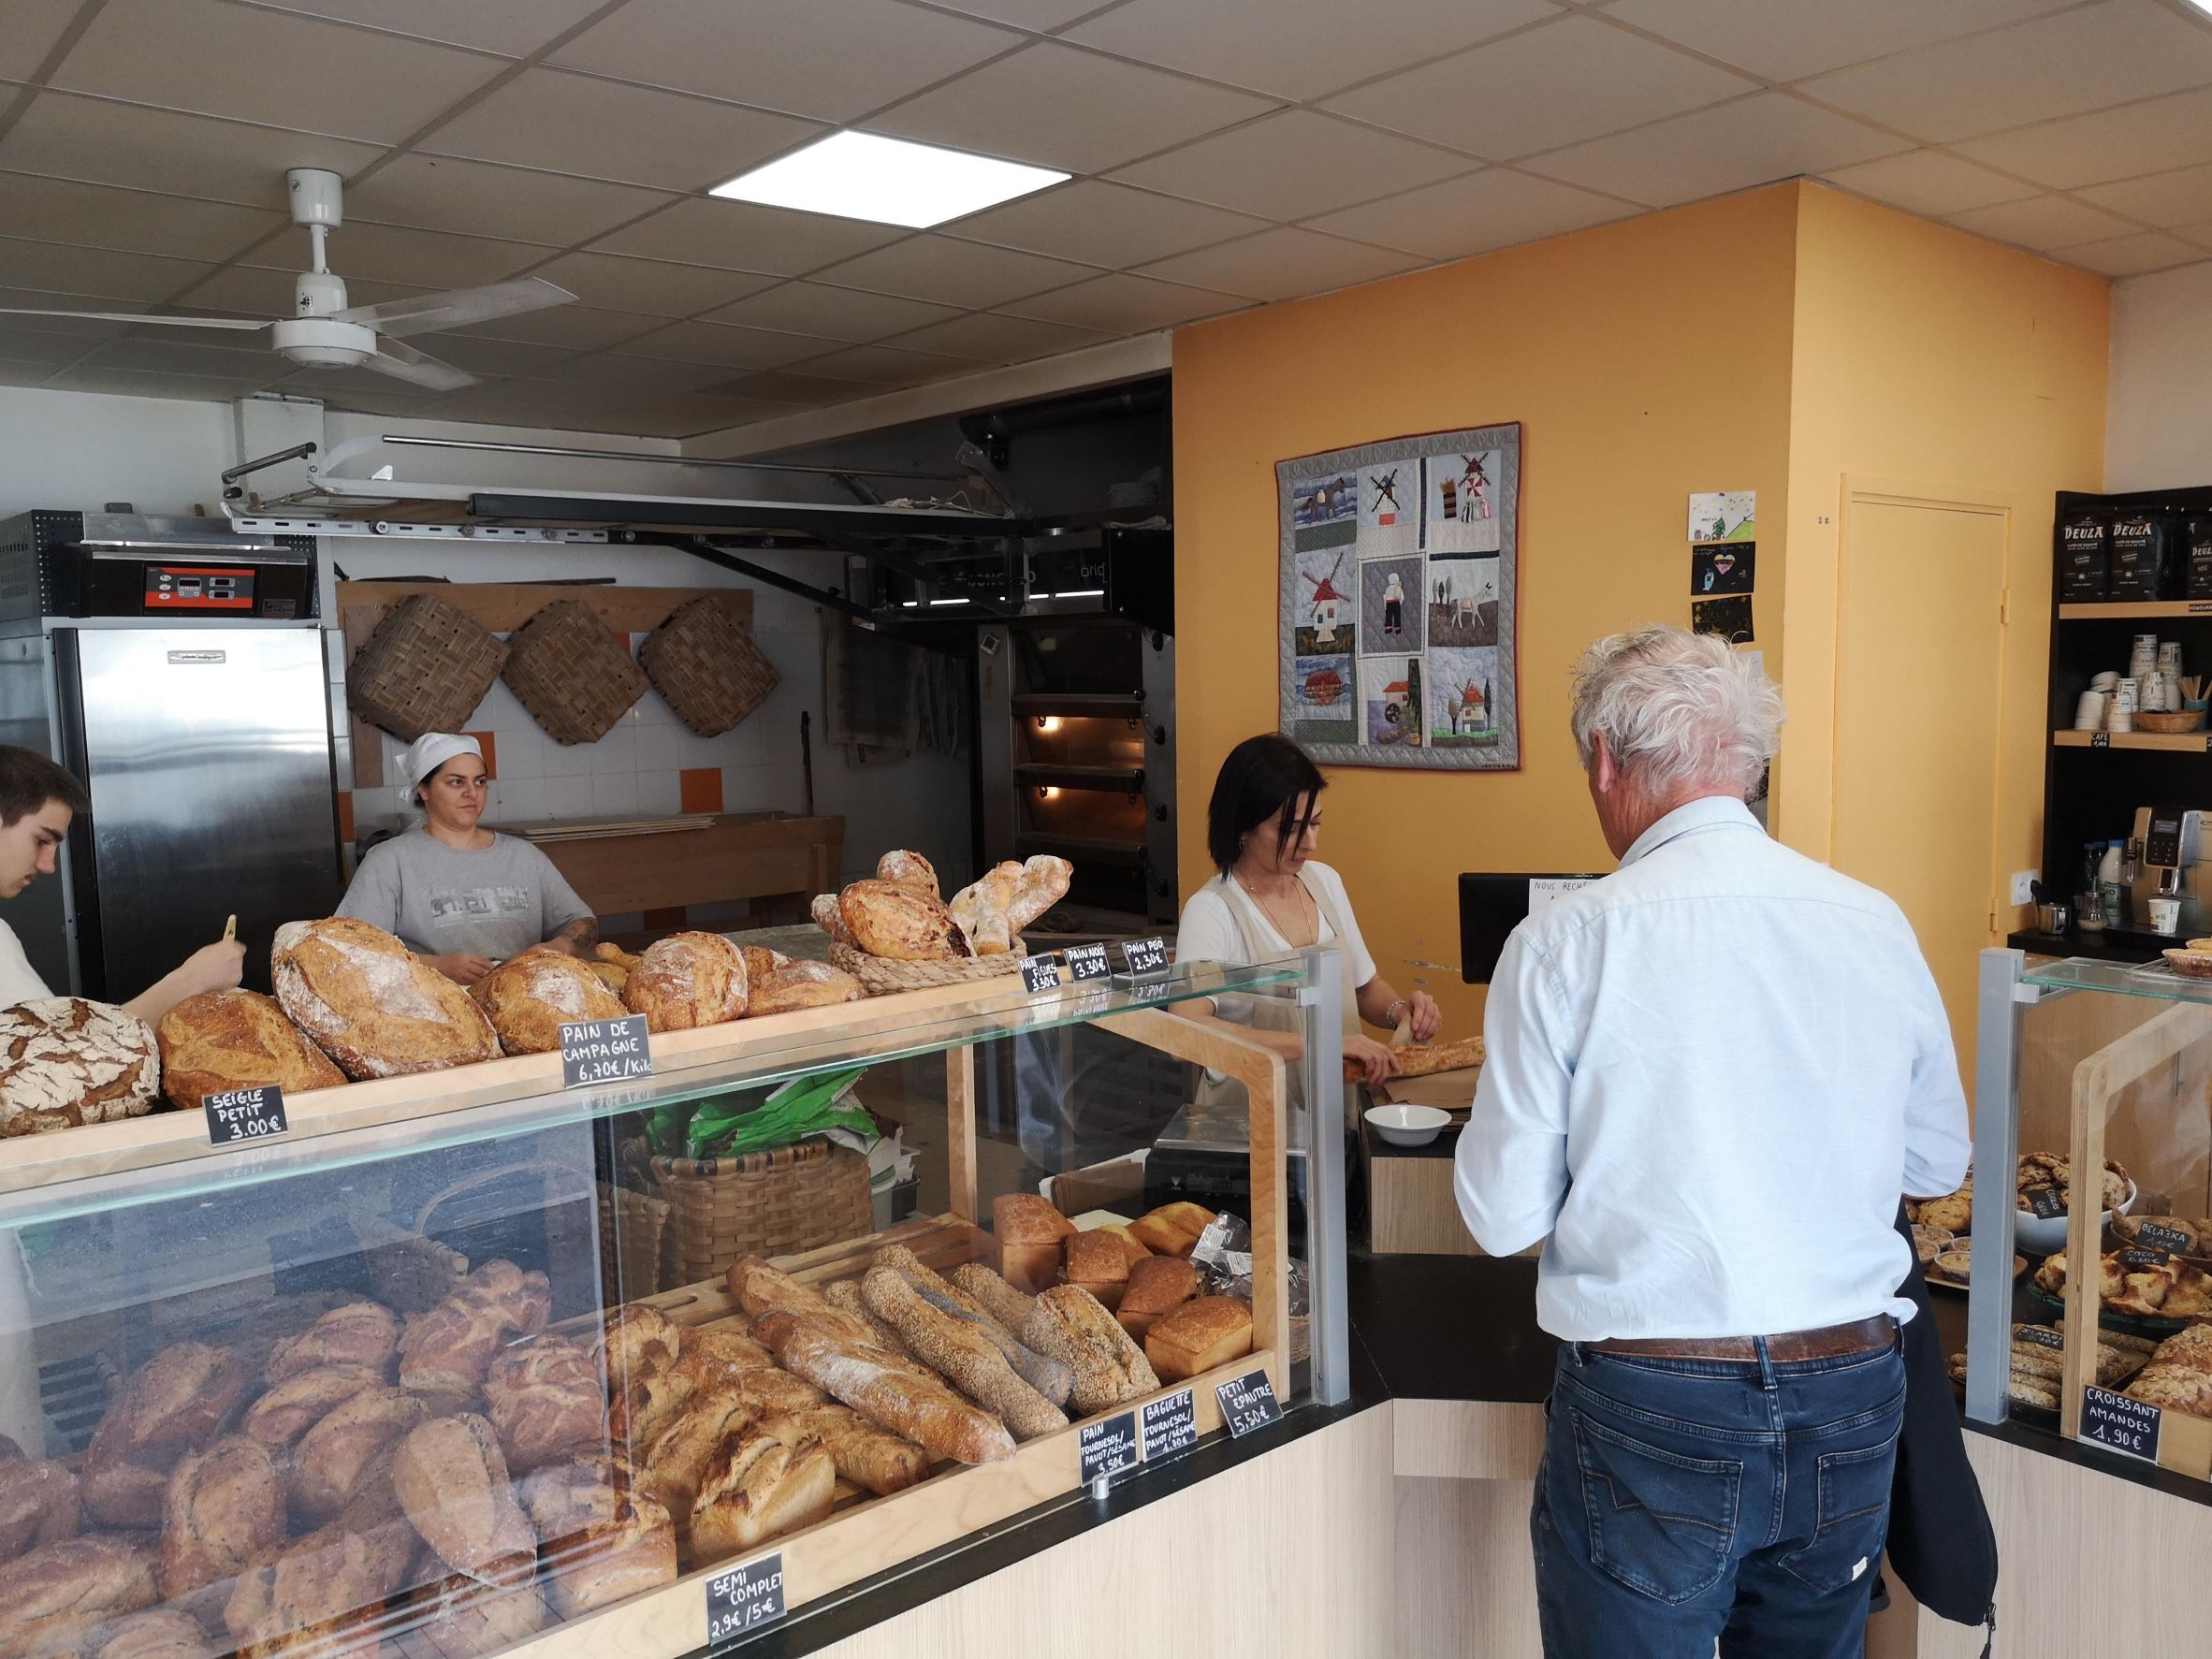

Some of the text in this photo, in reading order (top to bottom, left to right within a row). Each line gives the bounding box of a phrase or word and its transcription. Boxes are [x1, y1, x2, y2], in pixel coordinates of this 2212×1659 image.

[2064, 526, 2104, 540] DEUZA
[2113, 523, 2152, 536] DEUZA
[2192, 546, 2212, 556] DEUZ
[1534, 881, 1555, 890] NOUS
[610, 1021, 630, 1037] DE
[562, 1038, 640, 1062] CAMPAGNE
[229, 1115, 282, 1140] 3.00€
[1146, 1390, 1190, 1420] BAGUETTE
[1232, 1383, 1273, 1409] EPAUTRE
[2089, 1406, 2150, 1433] AMANDES
[730, 1572, 783, 1606] COMPLET
